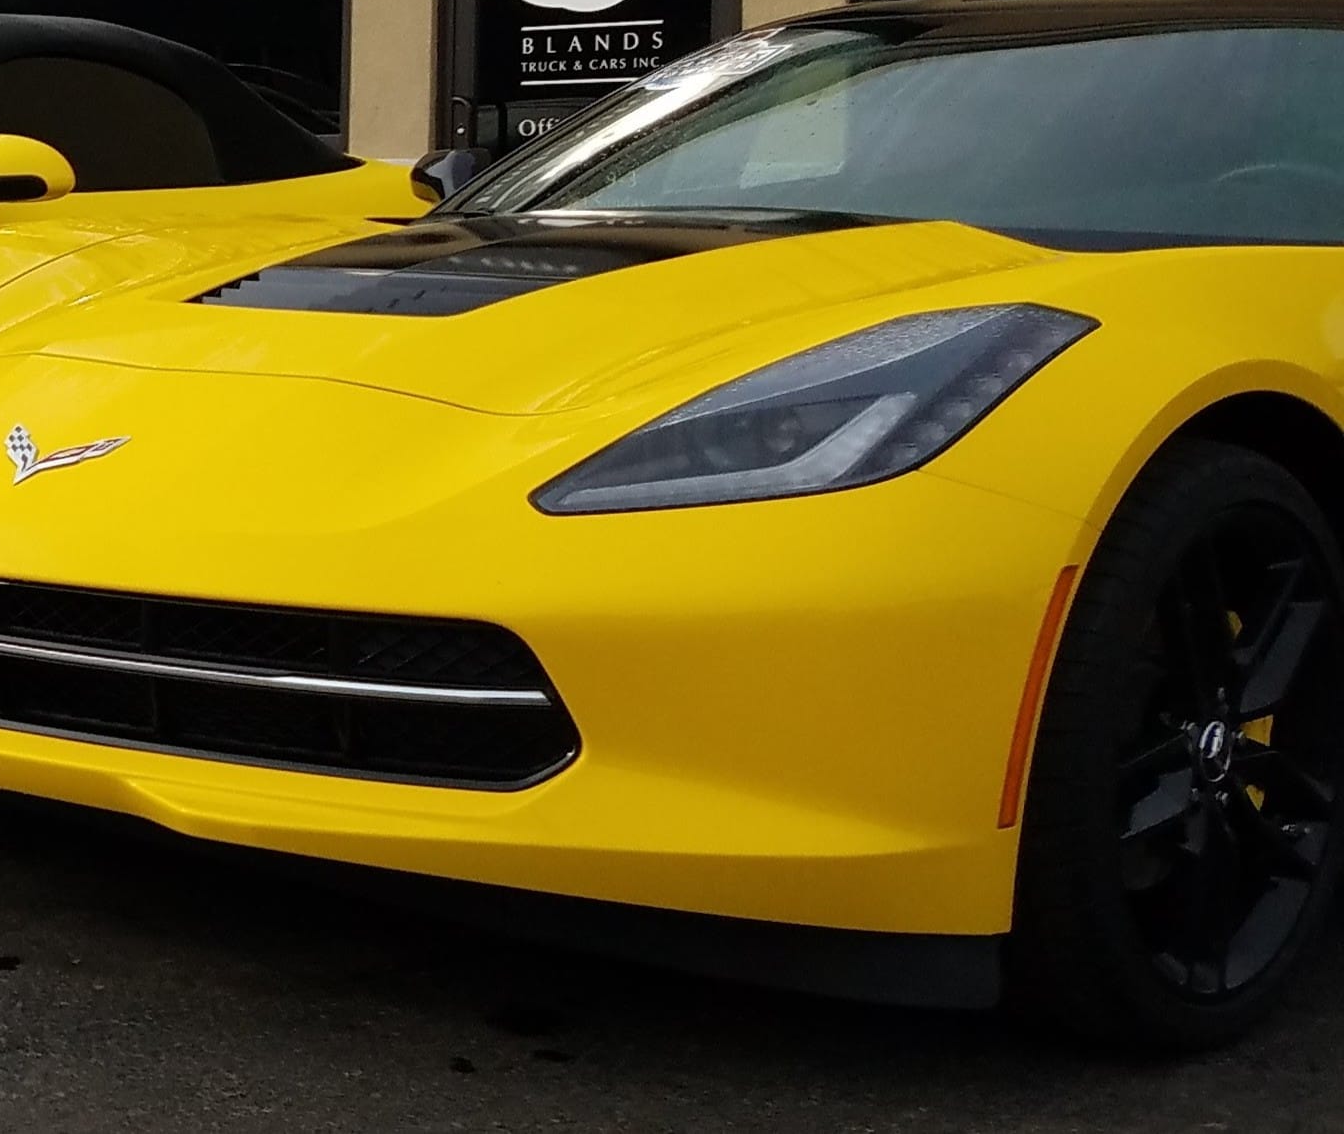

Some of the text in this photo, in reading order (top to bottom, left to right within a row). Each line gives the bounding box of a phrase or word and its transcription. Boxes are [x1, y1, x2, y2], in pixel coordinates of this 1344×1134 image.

[522, 31, 664, 55] BLANDS
[520, 56, 665, 73] TRUCK & CARS INC.
